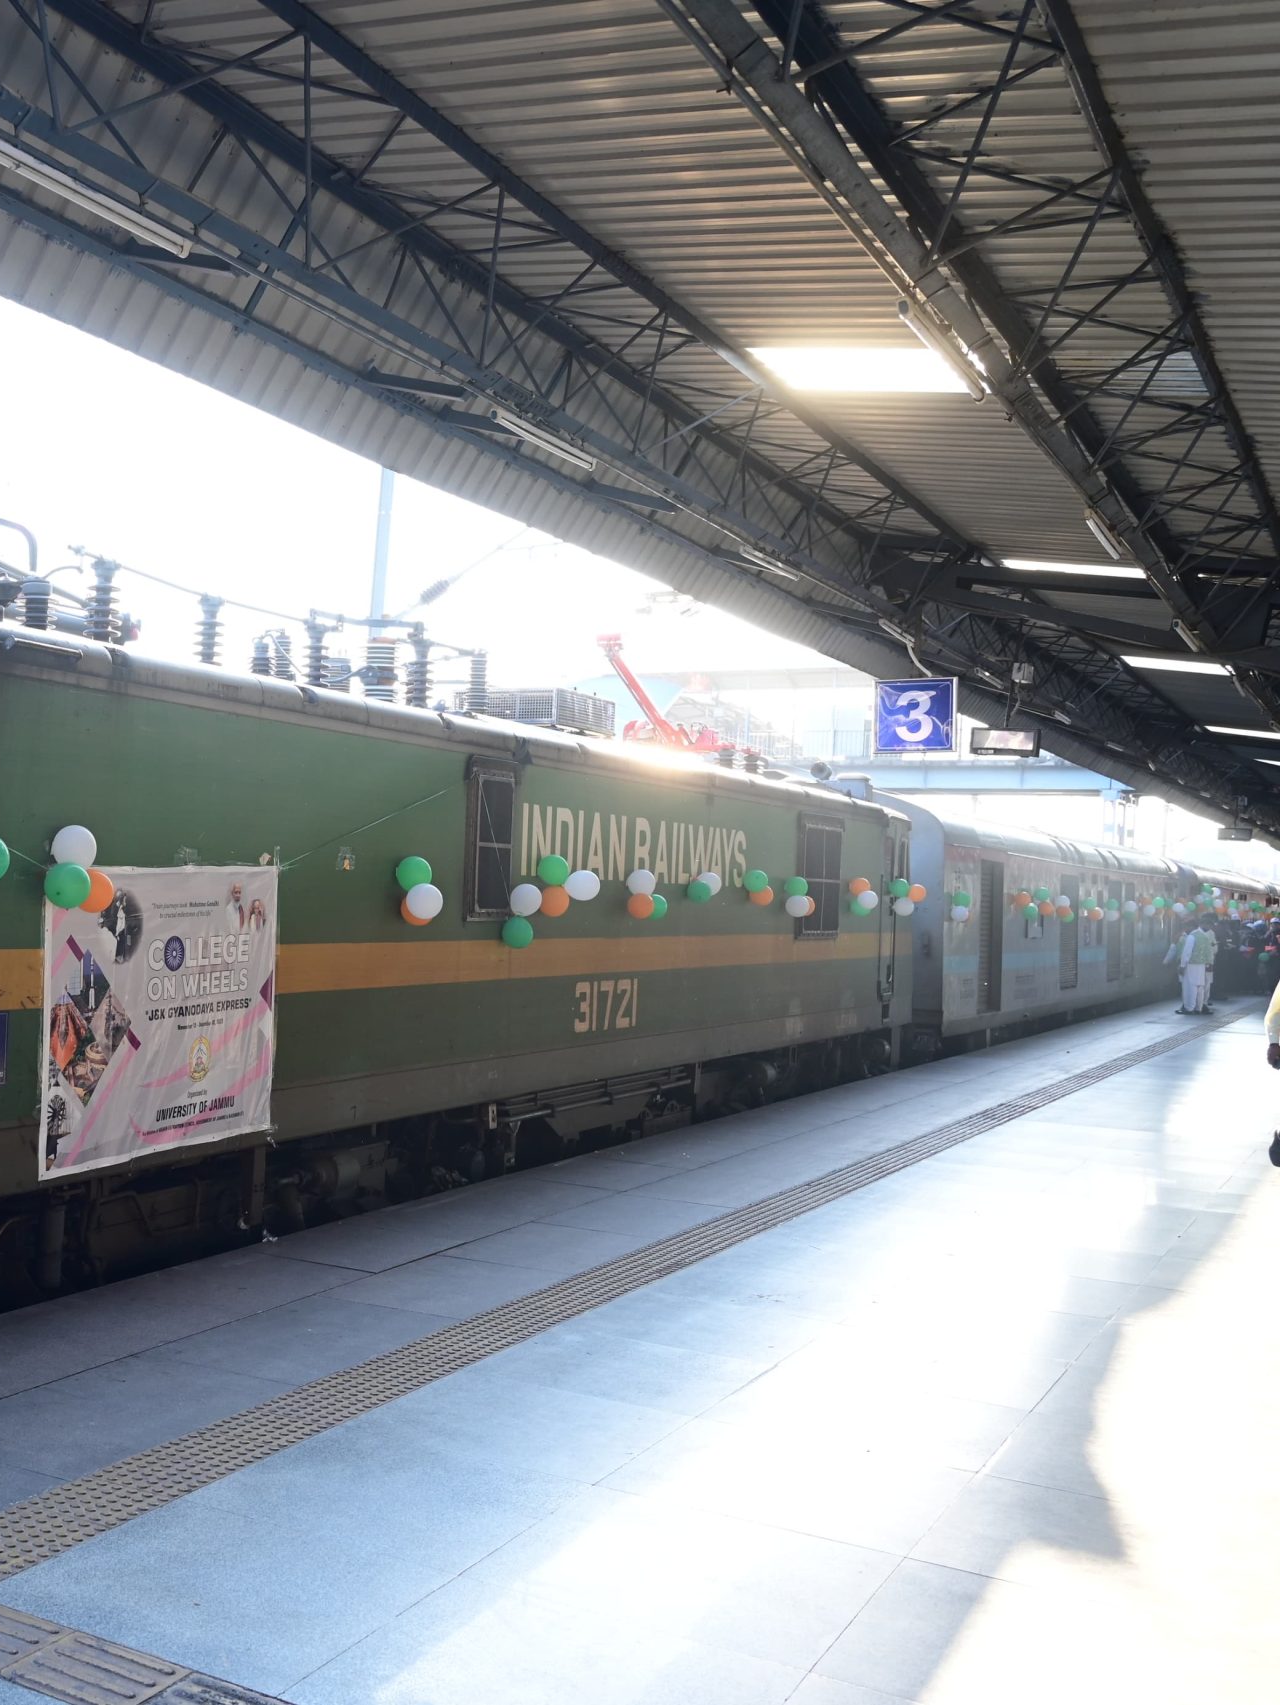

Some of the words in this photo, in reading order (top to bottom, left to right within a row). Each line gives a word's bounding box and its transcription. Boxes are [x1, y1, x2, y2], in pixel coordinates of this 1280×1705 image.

[895, 690, 937, 742] 3
[520, 802, 627, 882] INDIAN
[633, 816, 748, 889] RAILWAYS
[148, 933, 250, 972] COLLEGE
[147, 976, 176, 1001] ON
[182, 968, 248, 998] WHEELS
[168, 1002, 214, 1019] GYANODAYA
[574, 978, 638, 1033] 31721
[156, 1103, 197, 1122] UNIVERSITY
[199, 1101, 208, 1113] OF
[209, 1096, 235, 1111] JAMMU
